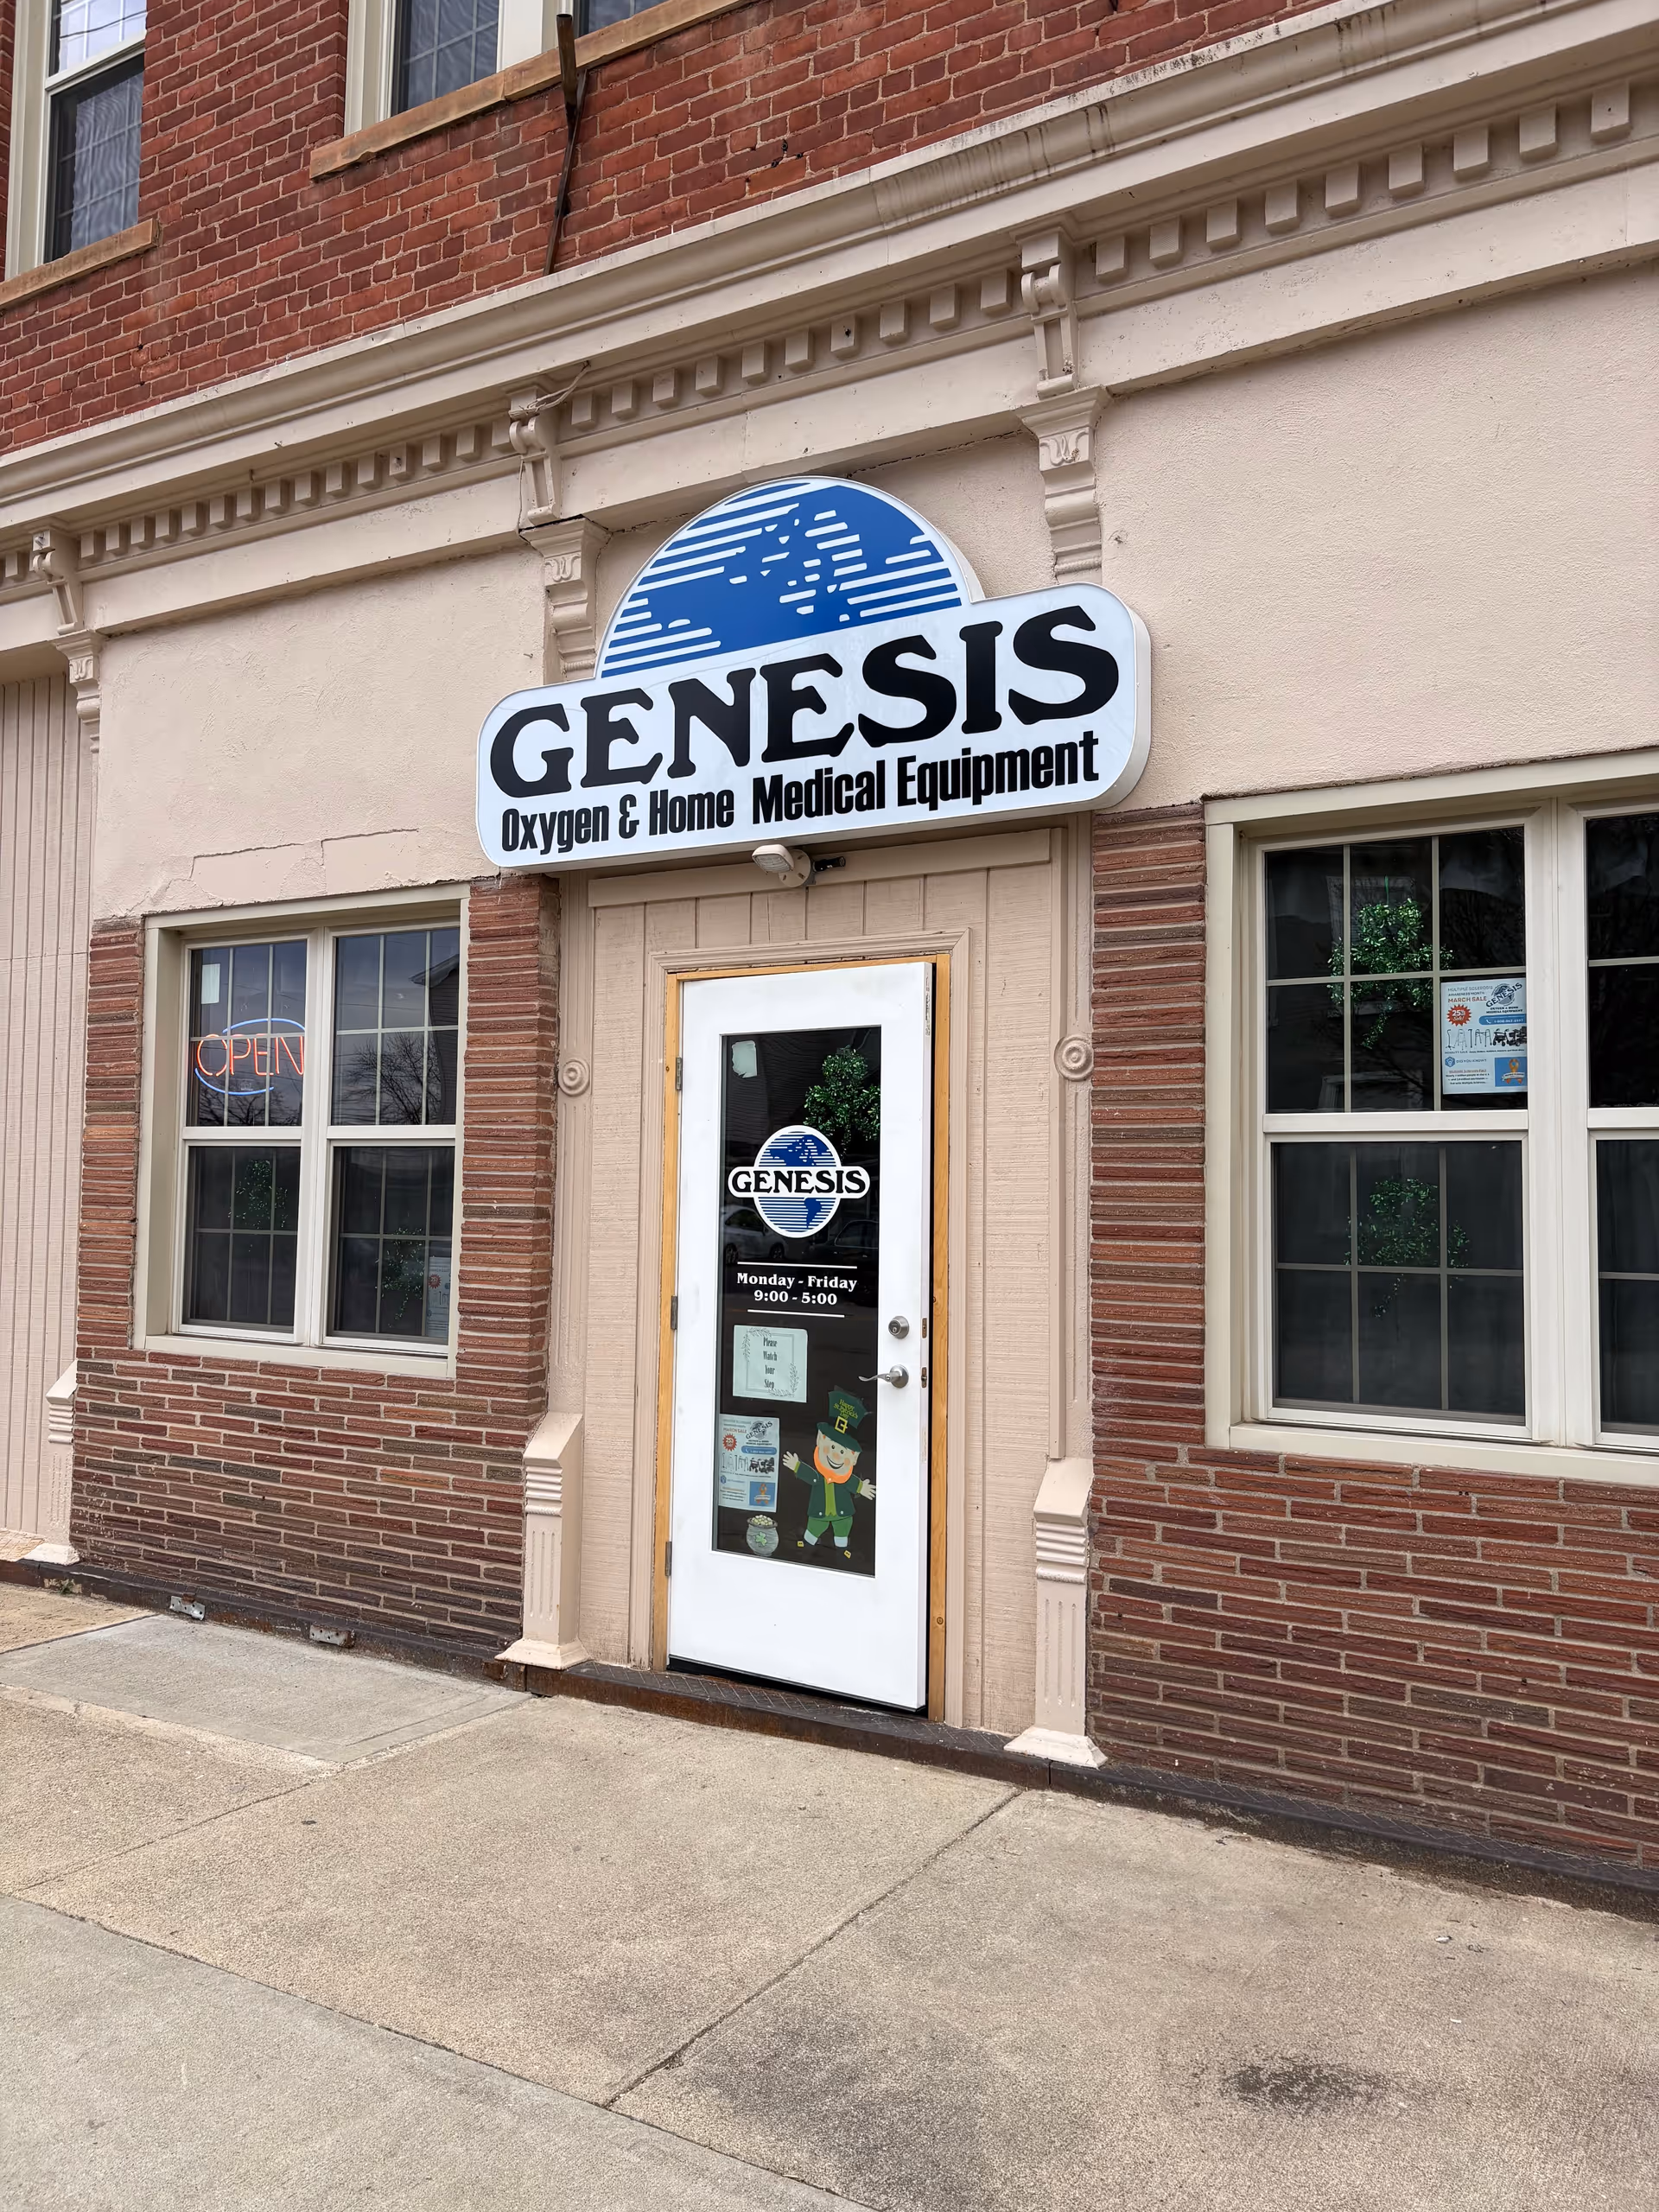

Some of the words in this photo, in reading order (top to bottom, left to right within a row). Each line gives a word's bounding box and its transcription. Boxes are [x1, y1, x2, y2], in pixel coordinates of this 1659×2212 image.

[490, 605, 1119, 798] GENESIS
[501, 805, 609, 855] Oxygen
[619, 793, 640, 839] &
[649, 789, 734, 836] Home
[753, 760, 886, 825] Medical
[897, 730, 1099, 807] Equipment
[1485, 982, 1523, 1007] GENESIS
[196, 1033, 304, 1077] OPEN
[732, 1170, 867, 1194] GENESIS
[737, 1272, 795, 1289] Monday
[807, 1274, 857, 1293] Friday
[753, 1289, 789, 1303] 9:00
[801, 1292, 838, 1306] 5:00
[763, 1337, 778, 1347] Please
[763, 1351, 778, 1361] Watch
[764, 1378, 775, 1391] Step
[746, 1421, 773, 1440] GENESIS
